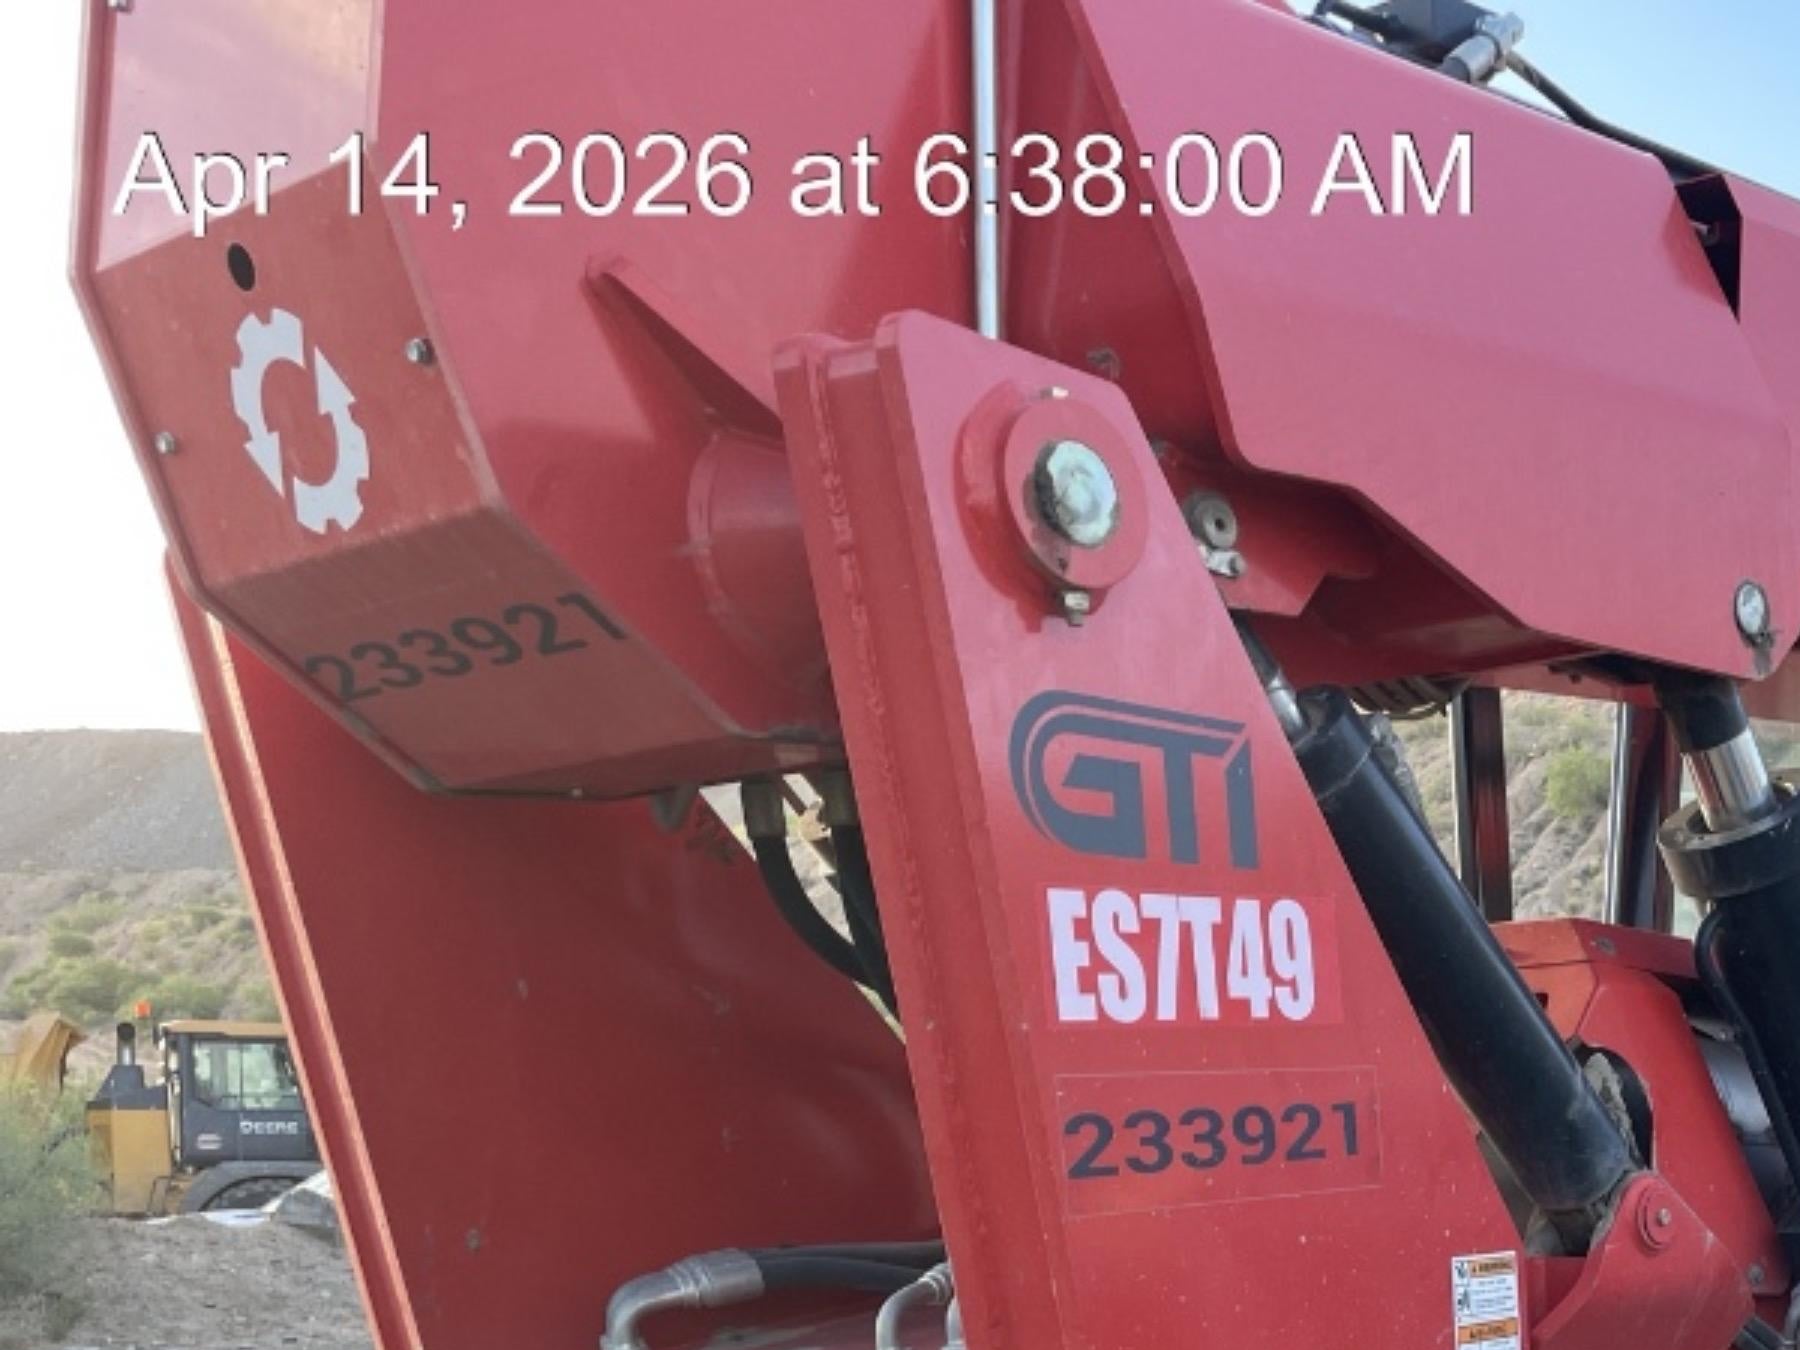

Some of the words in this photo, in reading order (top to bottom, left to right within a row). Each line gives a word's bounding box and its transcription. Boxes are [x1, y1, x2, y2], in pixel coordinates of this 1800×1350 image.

[306, 591, 628, 706] 233921
[1045, 887, 1316, 1023] ES7T49
[1063, 1100, 1361, 1181] 233921
